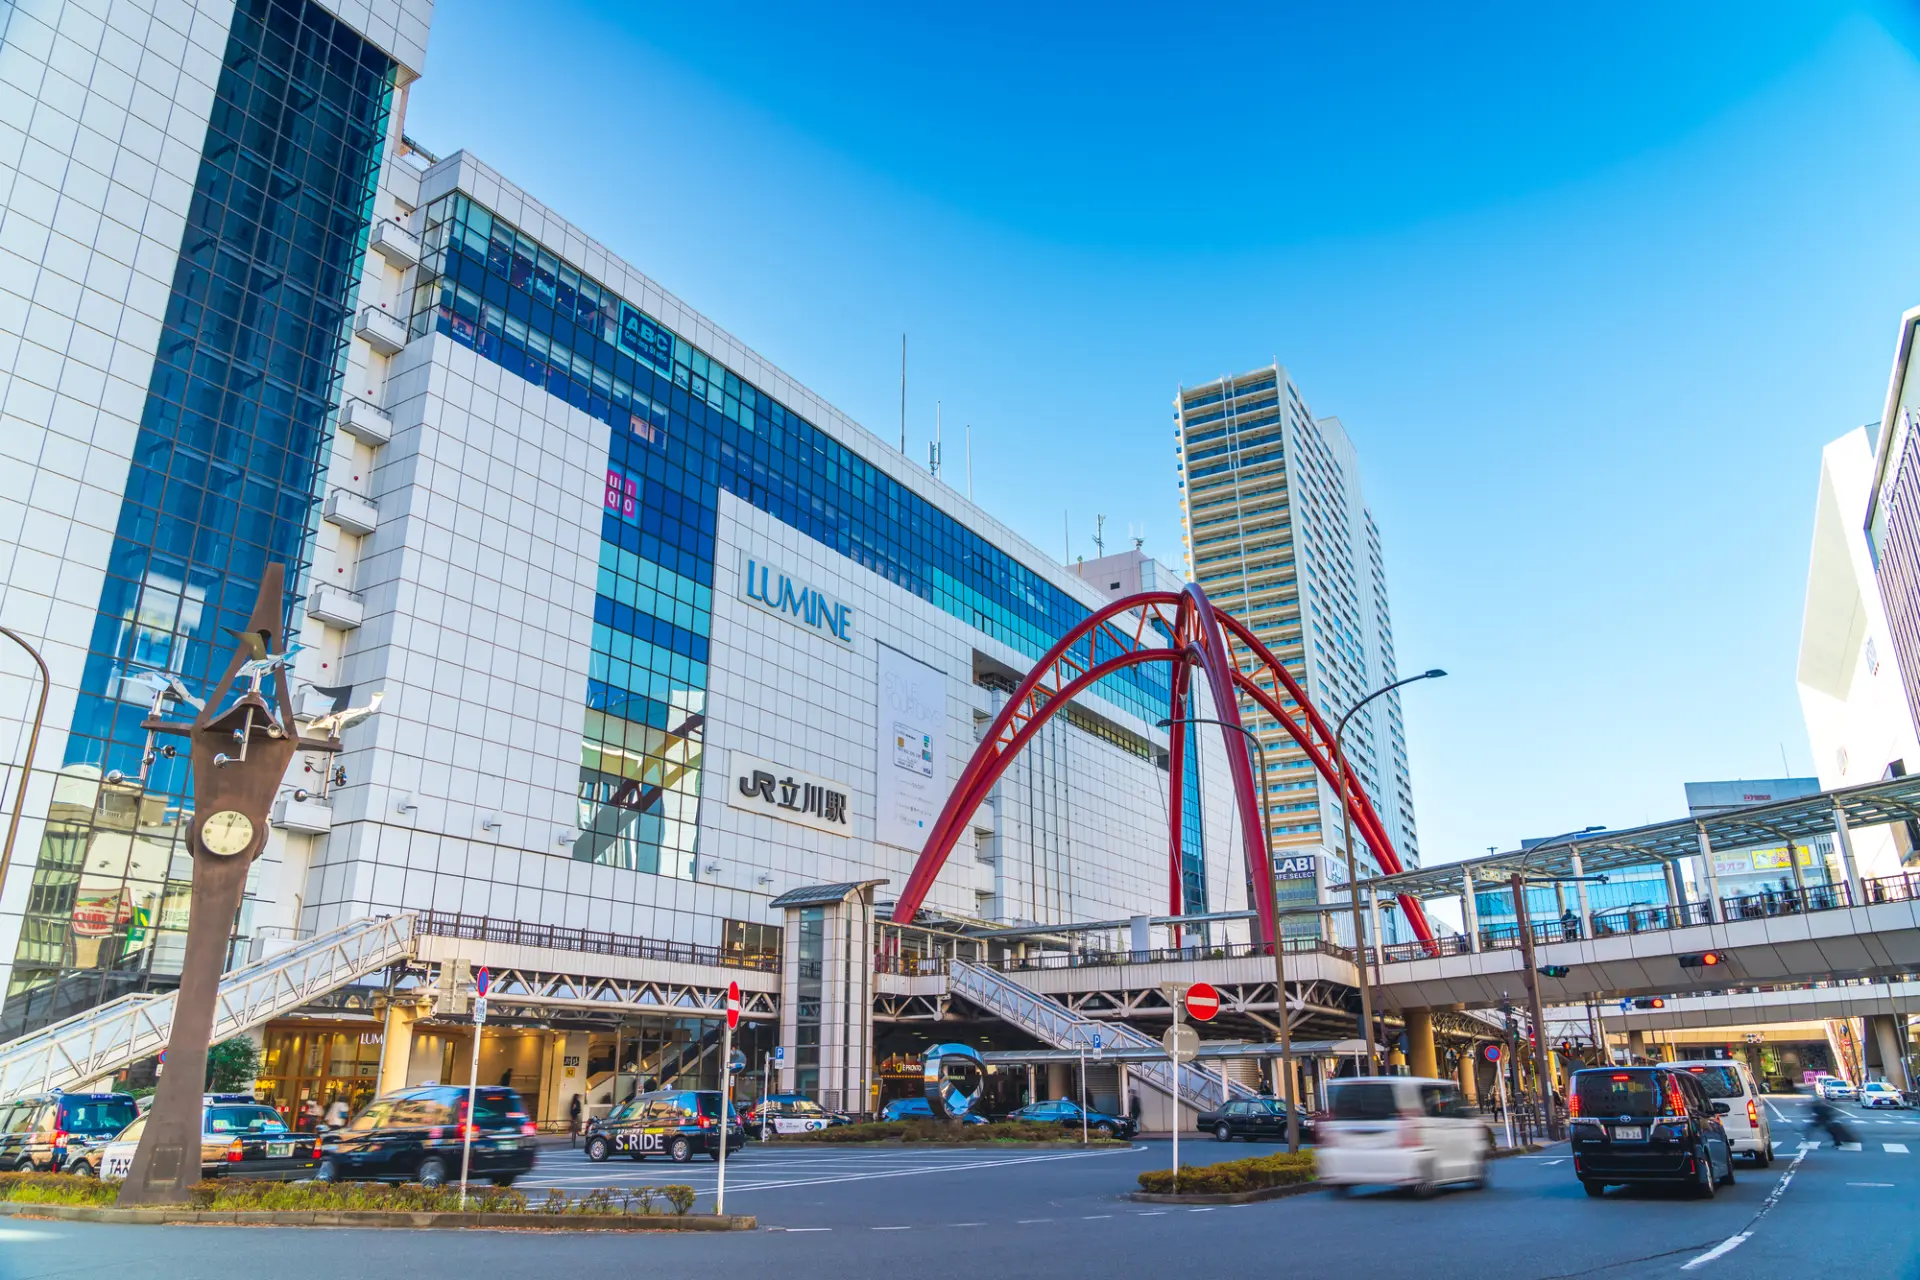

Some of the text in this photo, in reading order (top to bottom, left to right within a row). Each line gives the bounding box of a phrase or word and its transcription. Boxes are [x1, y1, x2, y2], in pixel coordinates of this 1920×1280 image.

[626, 316, 669, 352] ABC
[747, 559, 852, 642] LUMINE
[739, 769, 847, 824] JR立川駅
[1274, 856, 1316, 874] LABI
[1274, 871, 1316, 881] IFE SELECT
[1094, 1035, 1100, 1047] P
[777, 1048, 784, 1059] P
[615, 1134, 664, 1150] S.RIDE
[110, 1158, 131, 1175] TAX
